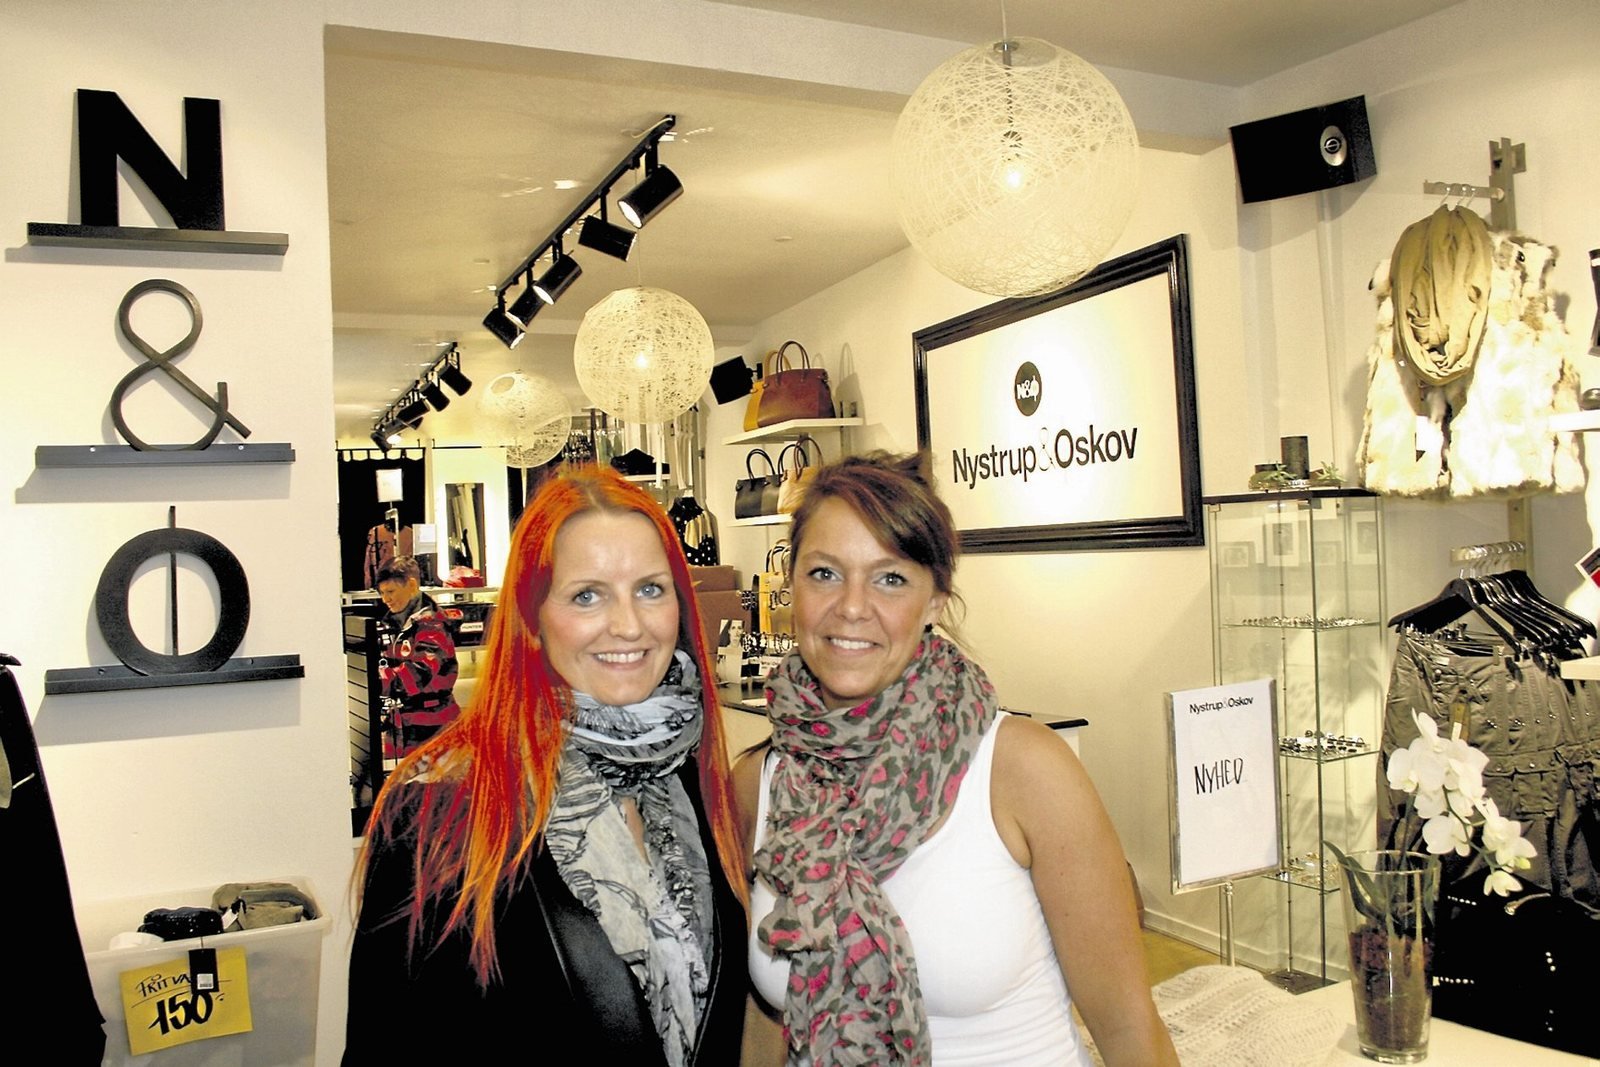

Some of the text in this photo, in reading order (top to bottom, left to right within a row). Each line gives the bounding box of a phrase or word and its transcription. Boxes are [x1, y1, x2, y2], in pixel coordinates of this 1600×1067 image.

[76, 88, 225, 231] N
[110, 278, 251, 452] &
[1194, 757, 1244, 795] NYHED
